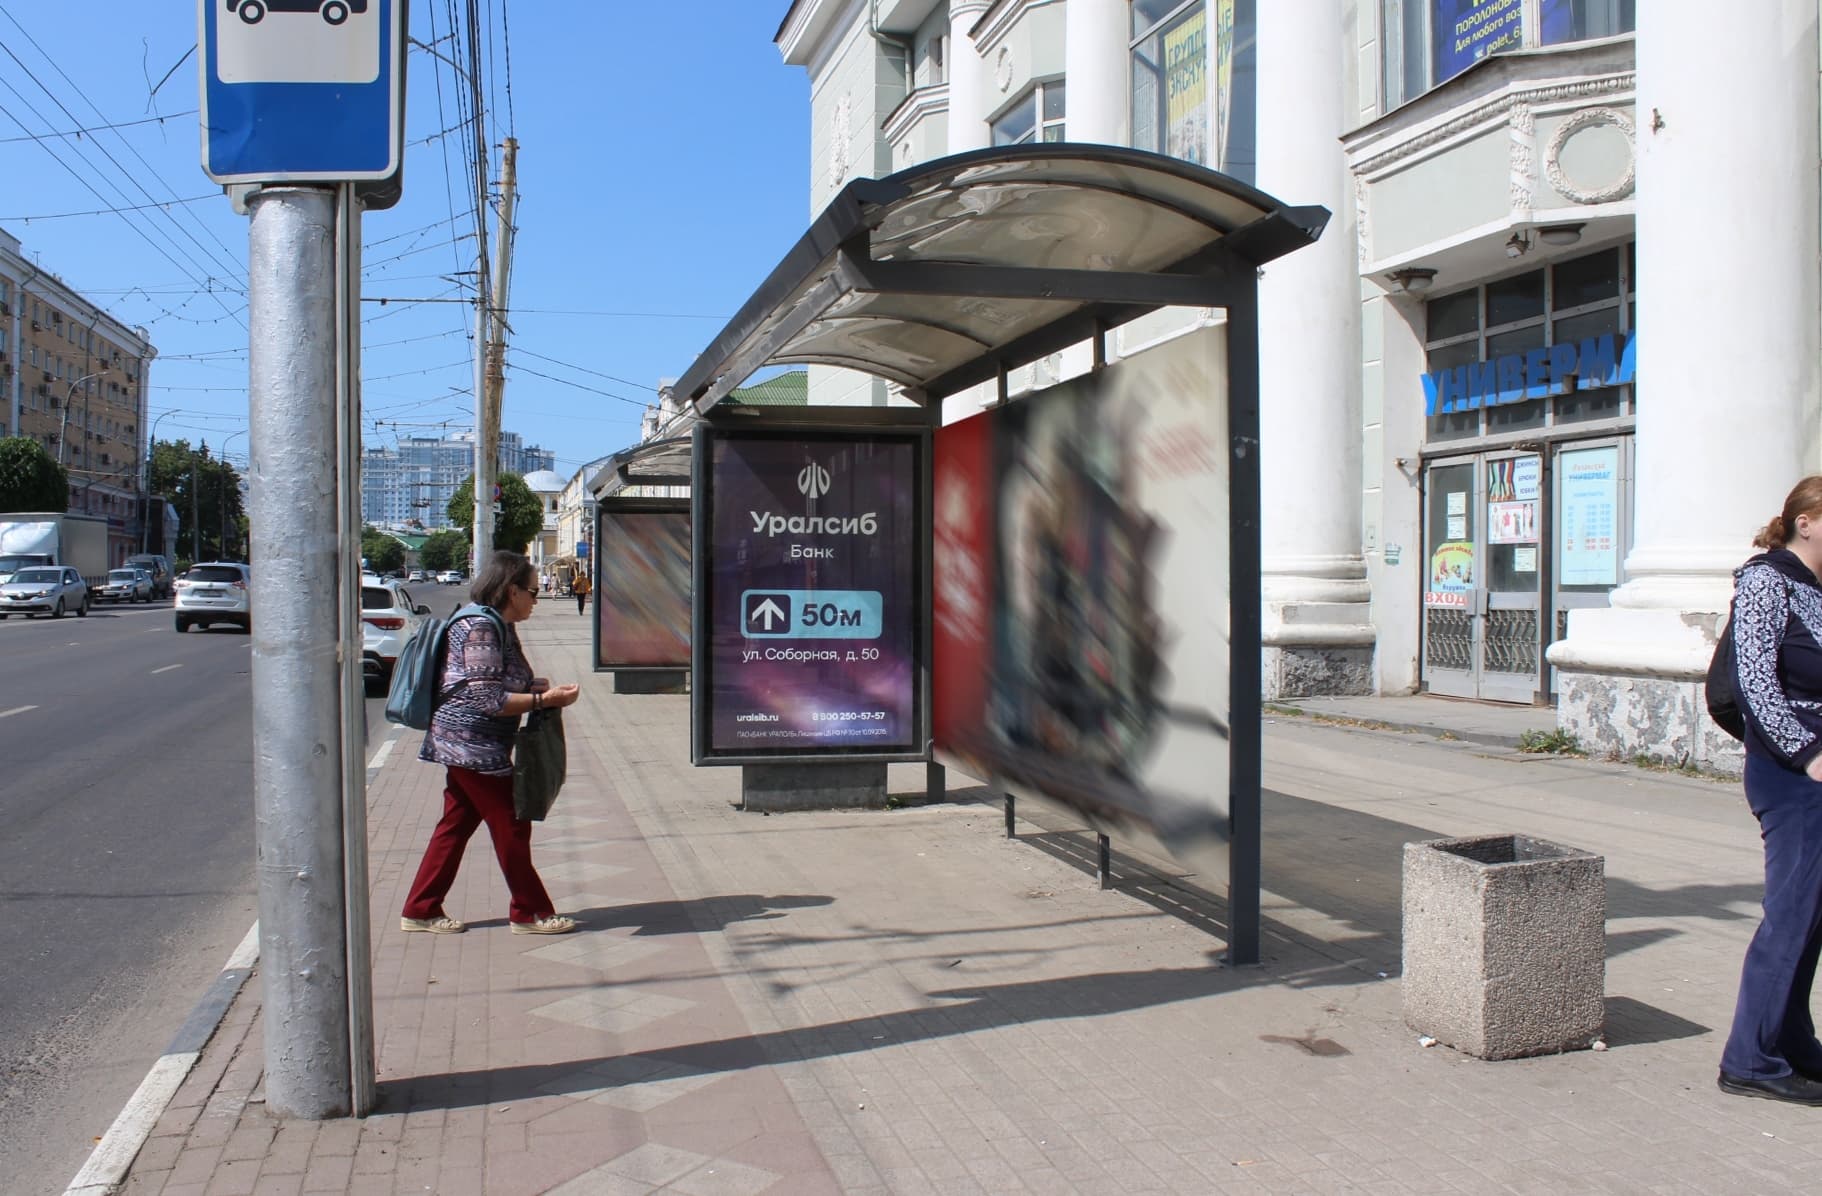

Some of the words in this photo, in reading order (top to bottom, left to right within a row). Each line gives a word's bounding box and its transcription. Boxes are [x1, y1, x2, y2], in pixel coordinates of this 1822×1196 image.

[1455, 37, 1471, 54] Для
[1472, 18, 1504, 43] любого
[750, 511, 878, 537] Уралсиб
[791, 544, 834, 558] Банк
[1425, 592, 1467, 606] ВХОД
[801, 603, 861, 627] 50м
[742, 651, 762, 663] ул.
[765, 647, 841, 662] Соборная,
[846, 652, 859, 662] д.
[861, 648, 879, 660] 50
[736, 712, 779, 722] uralsib.ru
[840, 711, 886, 721] 250-57-57
